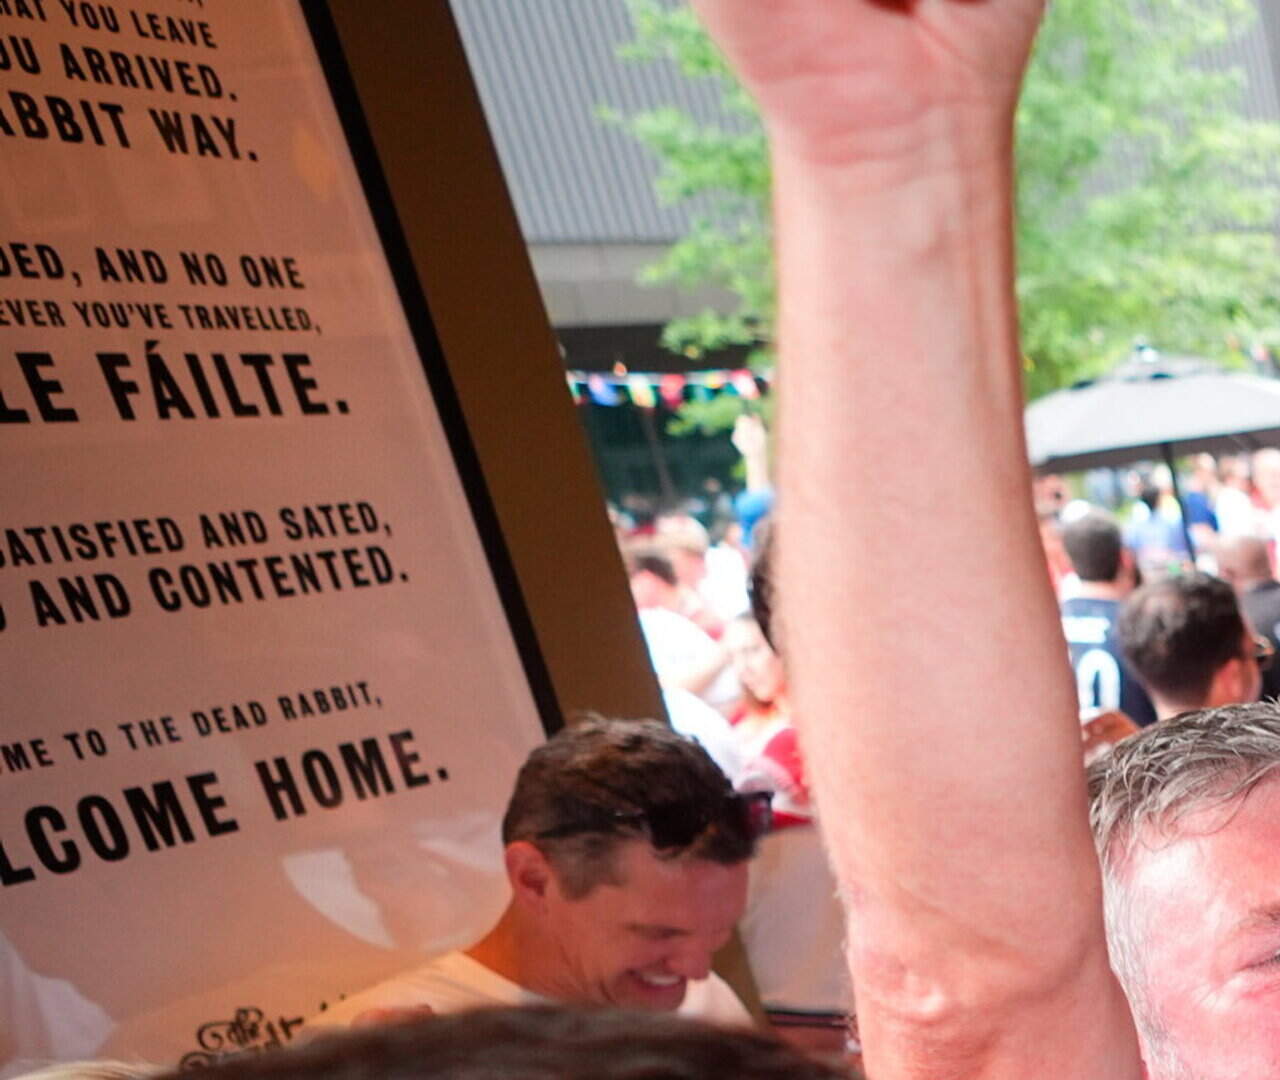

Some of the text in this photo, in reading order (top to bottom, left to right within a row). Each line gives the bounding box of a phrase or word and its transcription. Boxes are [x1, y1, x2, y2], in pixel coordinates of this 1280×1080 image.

[58, 0, 120, 33] YOU
[130, 10, 217, 48] LEAVE
[59, 43, 237, 101] ARRIVED.
[148, 107, 259, 162] WAY.
[95, 247, 169, 284] AND
[180, 252, 228, 287] NO
[239, 255, 305, 290] ONE
[73, 301, 174, 329] YOU'VE
[177, 304, 322, 335] TRAVELLED,
[95, 339, 350, 422] FÁILTE.
[199, 510, 269, 549] AND
[278, 501, 392, 541] SATED,
[28, 572, 132, 628] AND
[148, 545, 409, 613] CONTENTED.
[63, 728, 108, 761] TO
[118, 716, 182, 750] THE
[191, 699, 269, 738] DEAD
[277, 680, 383, 721] RABBIT,
[254, 729, 450, 822] HOME.
